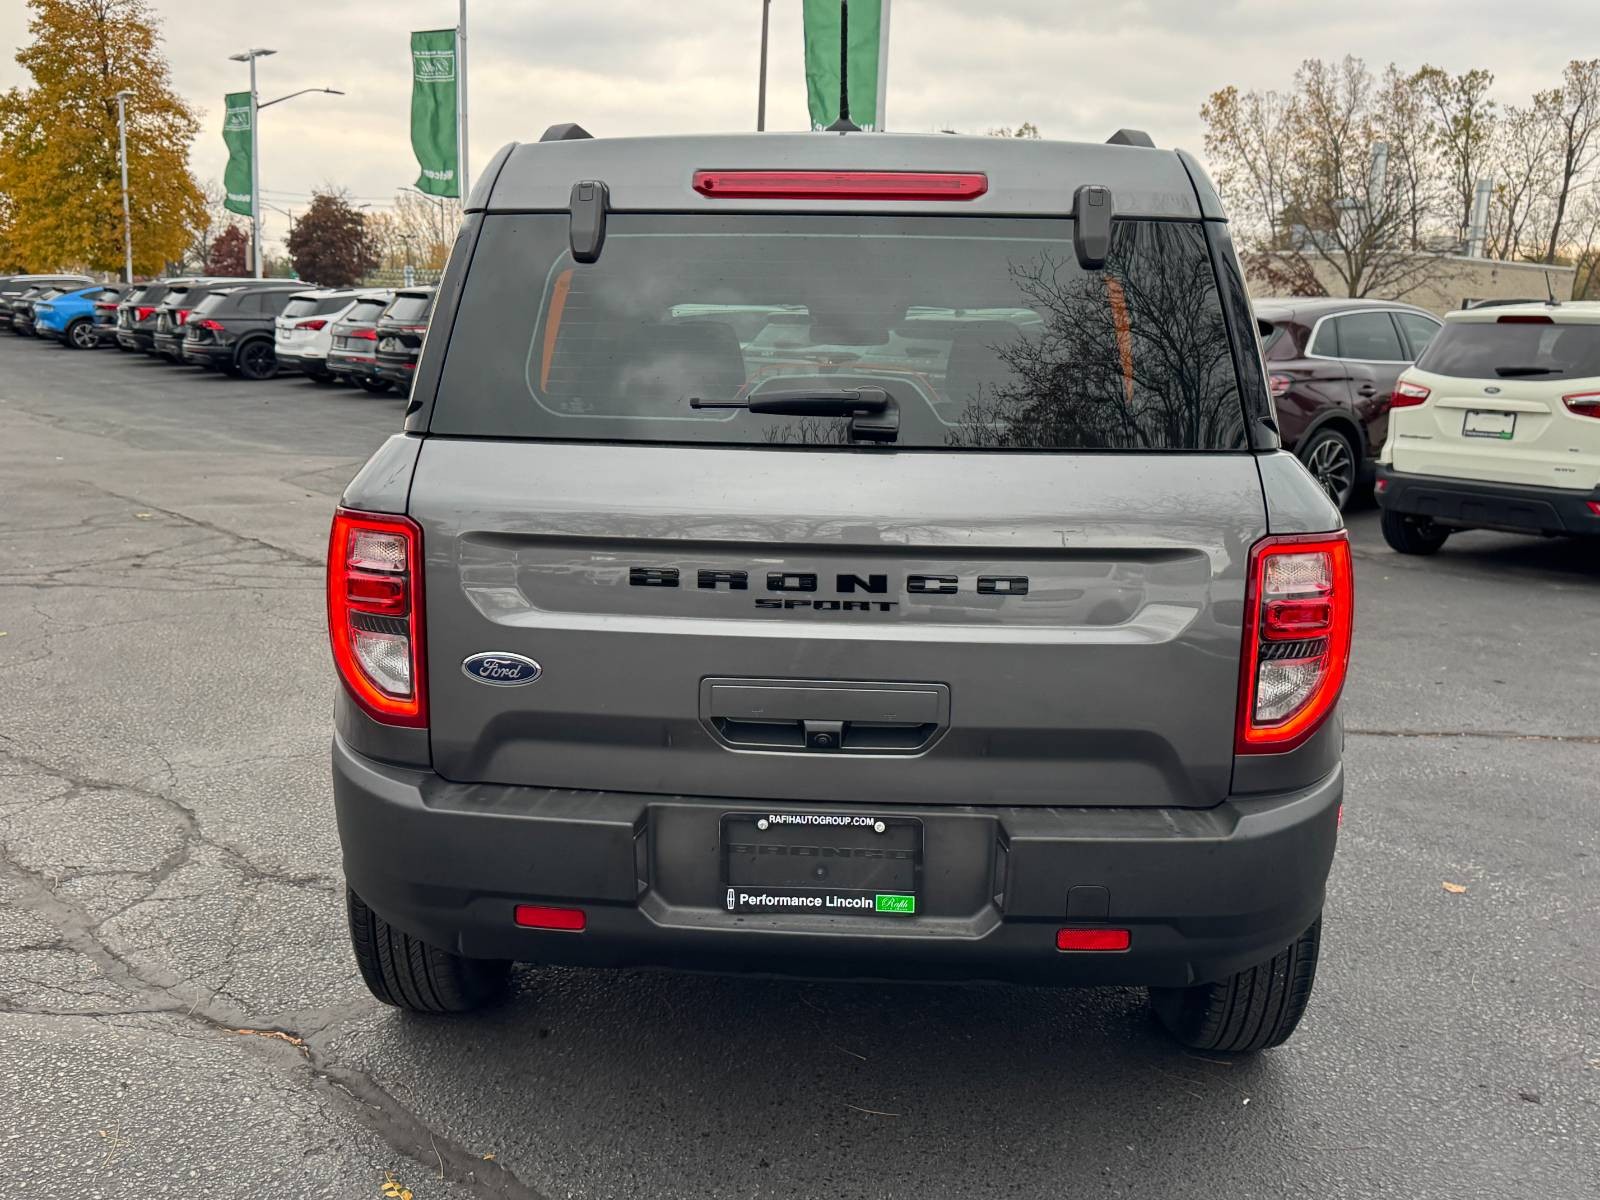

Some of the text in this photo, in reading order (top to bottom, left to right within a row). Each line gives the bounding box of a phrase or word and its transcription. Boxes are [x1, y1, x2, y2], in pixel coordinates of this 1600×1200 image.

[629, 566, 1030, 596] BRONCO
[755, 598, 898, 611] SPORT
[480, 658, 522, 678] Ford
[769, 815, 875, 826] RAFIHAUTOGROUP.COM
[739, 893, 874, 909] Performance Lincoln
